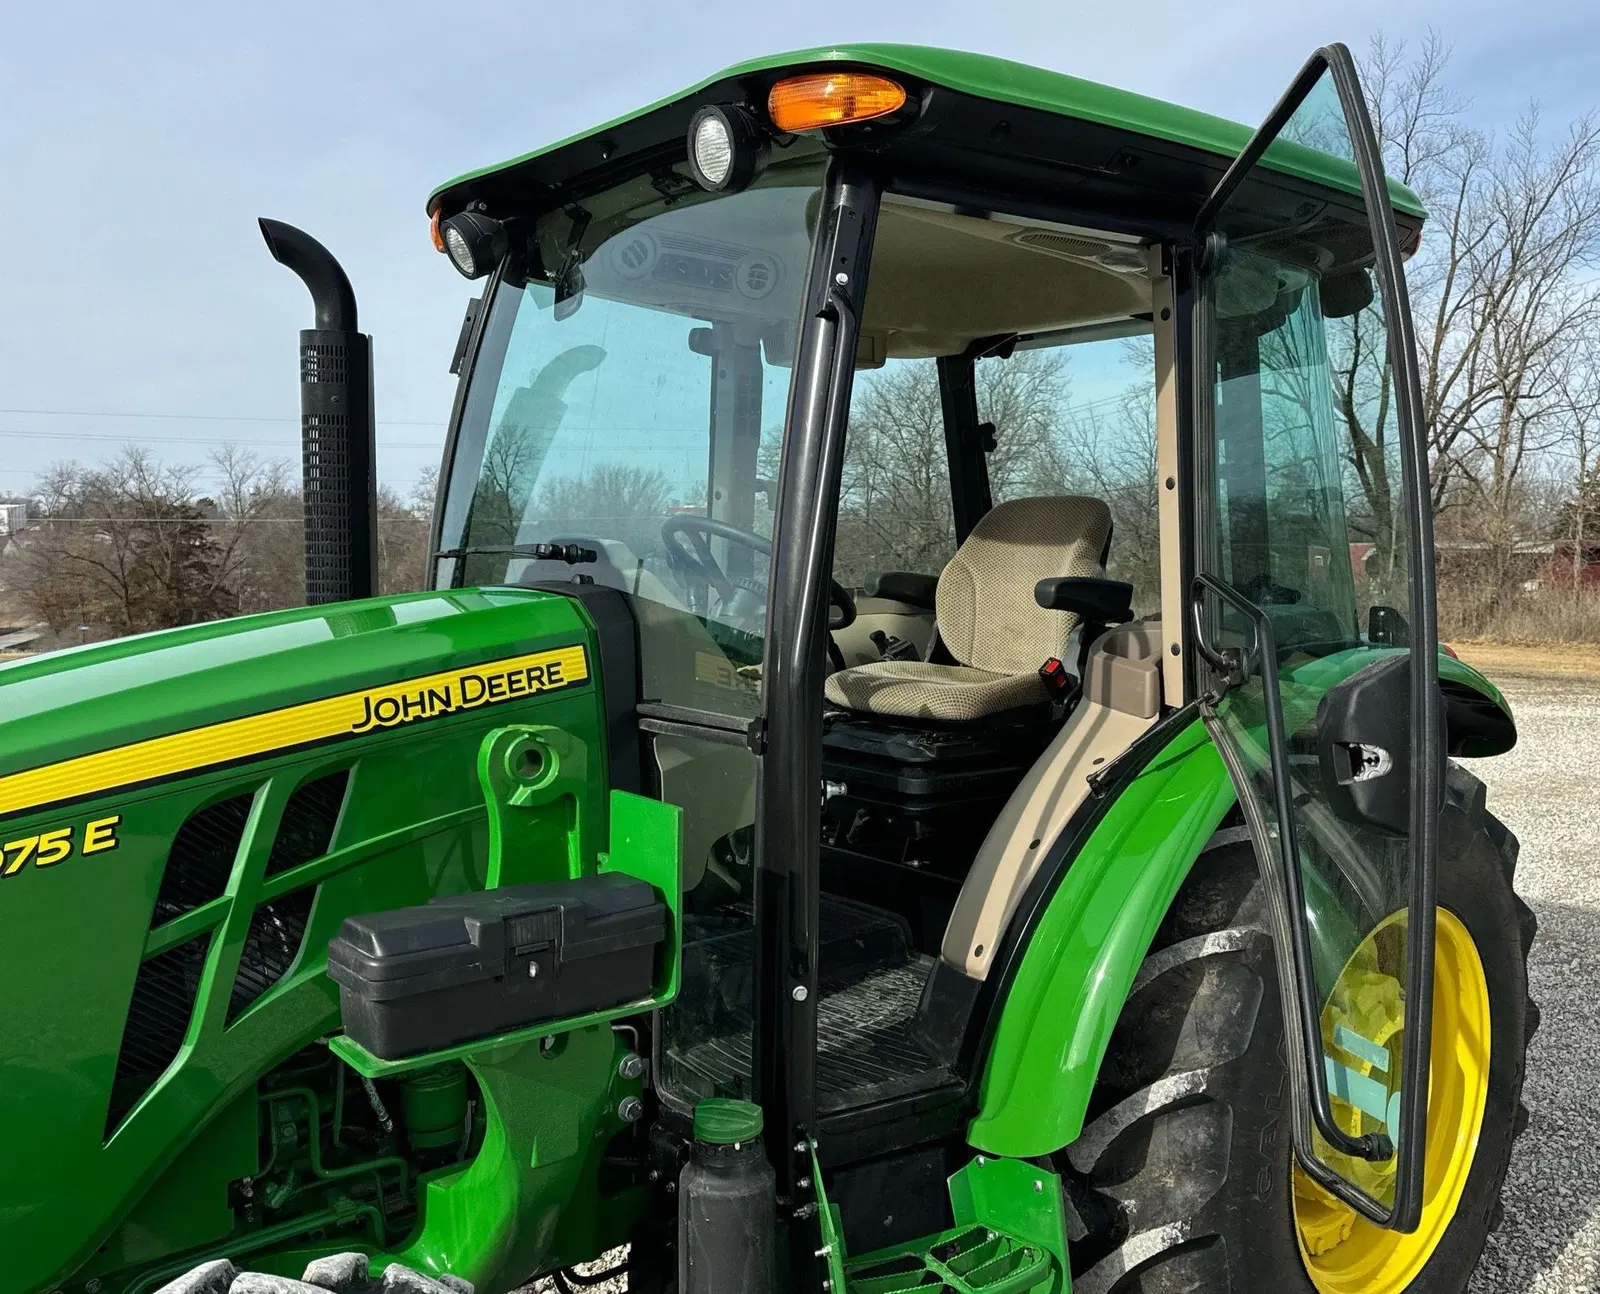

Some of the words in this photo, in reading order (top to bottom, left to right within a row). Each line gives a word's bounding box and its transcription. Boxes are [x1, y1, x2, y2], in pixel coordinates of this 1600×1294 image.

[352, 684, 453, 730] JOHN
[459, 660, 565, 704] DEERE
[0, 825, 73, 877] 75
[82, 815, 121, 855] E
